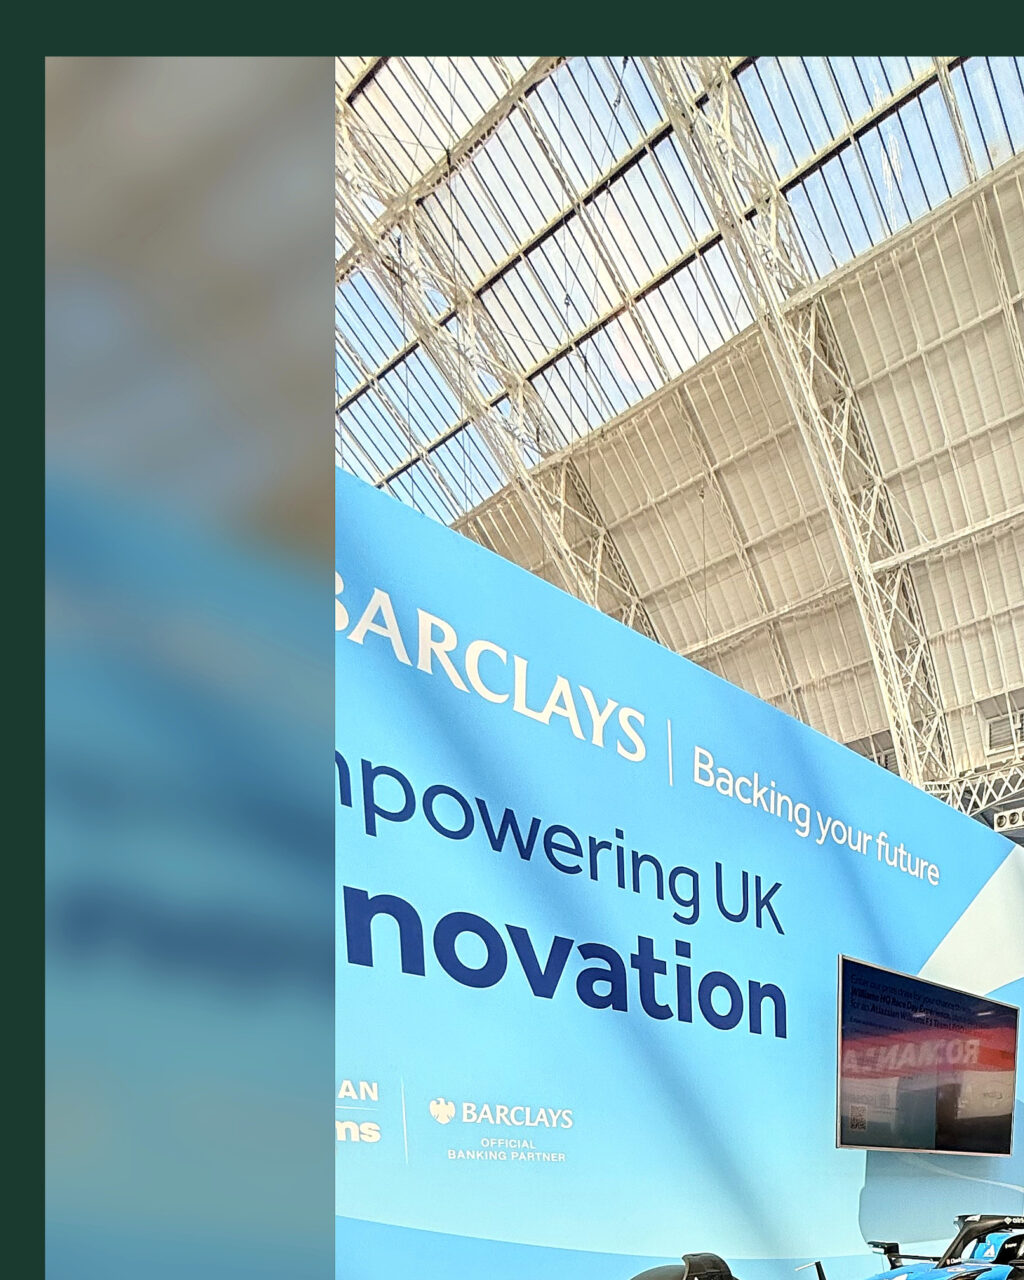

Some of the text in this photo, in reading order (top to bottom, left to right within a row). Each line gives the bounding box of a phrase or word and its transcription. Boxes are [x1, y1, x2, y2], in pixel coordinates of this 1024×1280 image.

[693, 745, 940, 886] Backing your future
[715, 861, 785, 936] UK
[342, 885, 788, 1039] novation
[337, 1079, 379, 1101] AN
[461, 1101, 574, 1129] BARCLAYS
[447, 1149, 566, 1163] BANKING PARTNER
[480, 1137, 537, 1149] OFFICIAL
